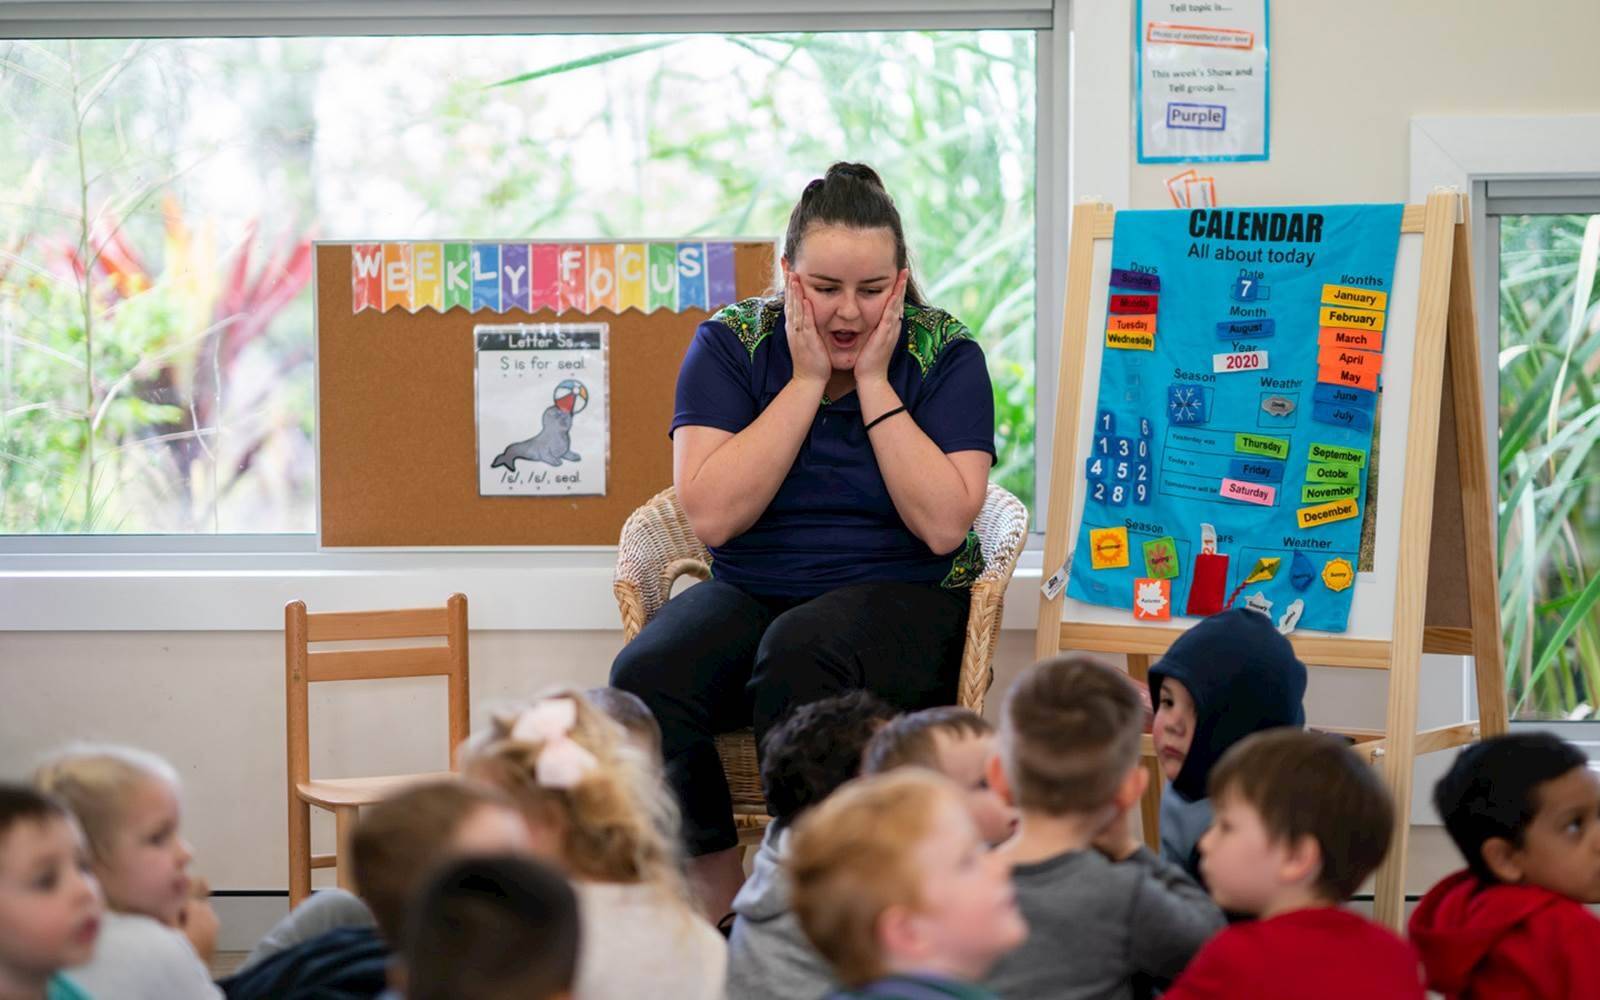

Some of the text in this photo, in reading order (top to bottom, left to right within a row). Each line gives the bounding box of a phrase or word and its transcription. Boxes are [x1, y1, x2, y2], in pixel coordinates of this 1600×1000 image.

[1170, 4, 1186, 12] Tell
[1189, 3, 1211, 13] topic
[1152, 67, 1253, 79] This week's Show and
[1169, 84, 1185, 93] Tell
[1187, 85, 1215, 94] group
[1172, 108, 1222, 125] Purple
[1189, 208, 1325, 243] CALENDAR
[1188, 243, 1316, 269] All about today
[356, 250, 527, 296] WEEKLY
[560, 249, 701, 299] FOCUS
[1130, 261, 1159, 274] Days
[1240, 268, 1265, 280] Date
[1122, 273, 1153, 287] Sunday
[1241, 280, 1252, 297] 7
[1334, 290, 1377, 306] January
[1230, 305, 1267, 318] Month
[1329, 311, 1377, 326] February
[1117, 320, 1148, 331] Tuesday
[1229, 323, 1263, 335] August
[508, 333, 553, 348] Letter
[1108, 334, 1152, 347] Wednesday
[1336, 332, 1368, 345] March
[1232, 341, 1258, 352] Year
[500, 355, 510, 370] S
[515, 358, 526, 370] is
[531, 355, 549, 369] for
[1226, 354, 1259, 369] 2020
[1339, 353, 1364, 365] April
[1174, 367, 1216, 383] Season
[1341, 370, 1361, 384] May
[1333, 389, 1358, 402] June
[1103, 413, 1111, 430] 1
[1333, 409, 1354, 423] July
[1100, 437, 1108, 454] 1
[1119, 440, 1129, 456] 3
[1140, 441, 1147, 457] 0
[1242, 438, 1282, 454] Thursday
[1313, 446, 1362, 462] September
[1090, 459, 1102, 475] 4
[1117, 463, 1128, 478] 5
[1138, 465, 1147, 480] 2
[1243, 464, 1271, 478] Friday
[1094, 483, 1104, 499] 2
[1112, 486, 1123, 502] 8
[1137, 484, 1146, 501] 9
[1229, 483, 1269, 500] Saturday
[1307, 486, 1355, 498] November
[1303, 505, 1352, 522] December
[1125, 518, 1163, 534] Season
[1217, 533, 1234, 544] ars
[1283, 536, 1332, 549] Weather
